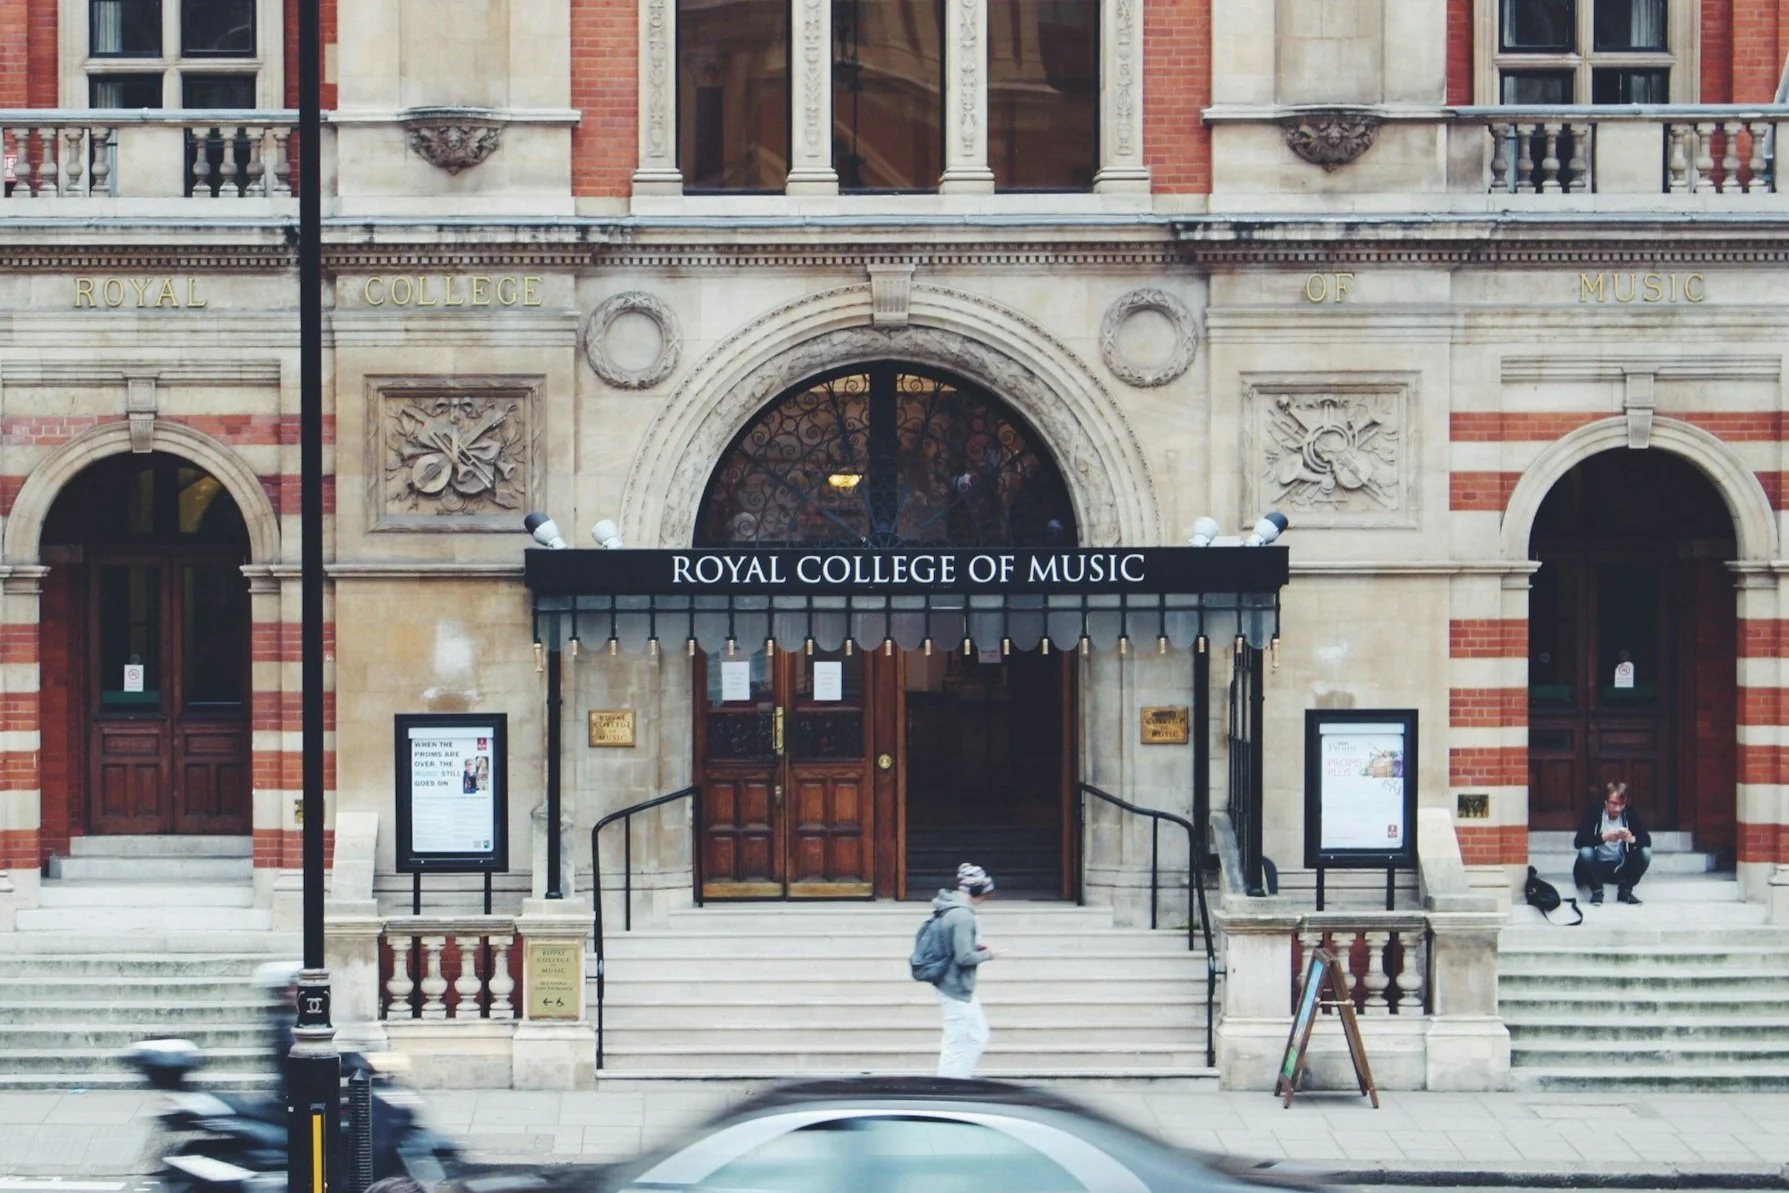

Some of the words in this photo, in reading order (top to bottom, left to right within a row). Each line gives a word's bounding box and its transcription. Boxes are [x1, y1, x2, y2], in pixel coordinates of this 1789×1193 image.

[74, 277, 208, 308] ROYAL
[363, 275, 545, 307] COLLEGE
[1305, 272, 1355, 302] OF
[1578, 272, 1707, 303] MUSIC
[671, 555, 787, 585] ROYAL
[796, 555, 956, 585] COLLEGE
[967, 555, 1016, 584] OF
[1027, 553, 1146, 584] MUSIC
